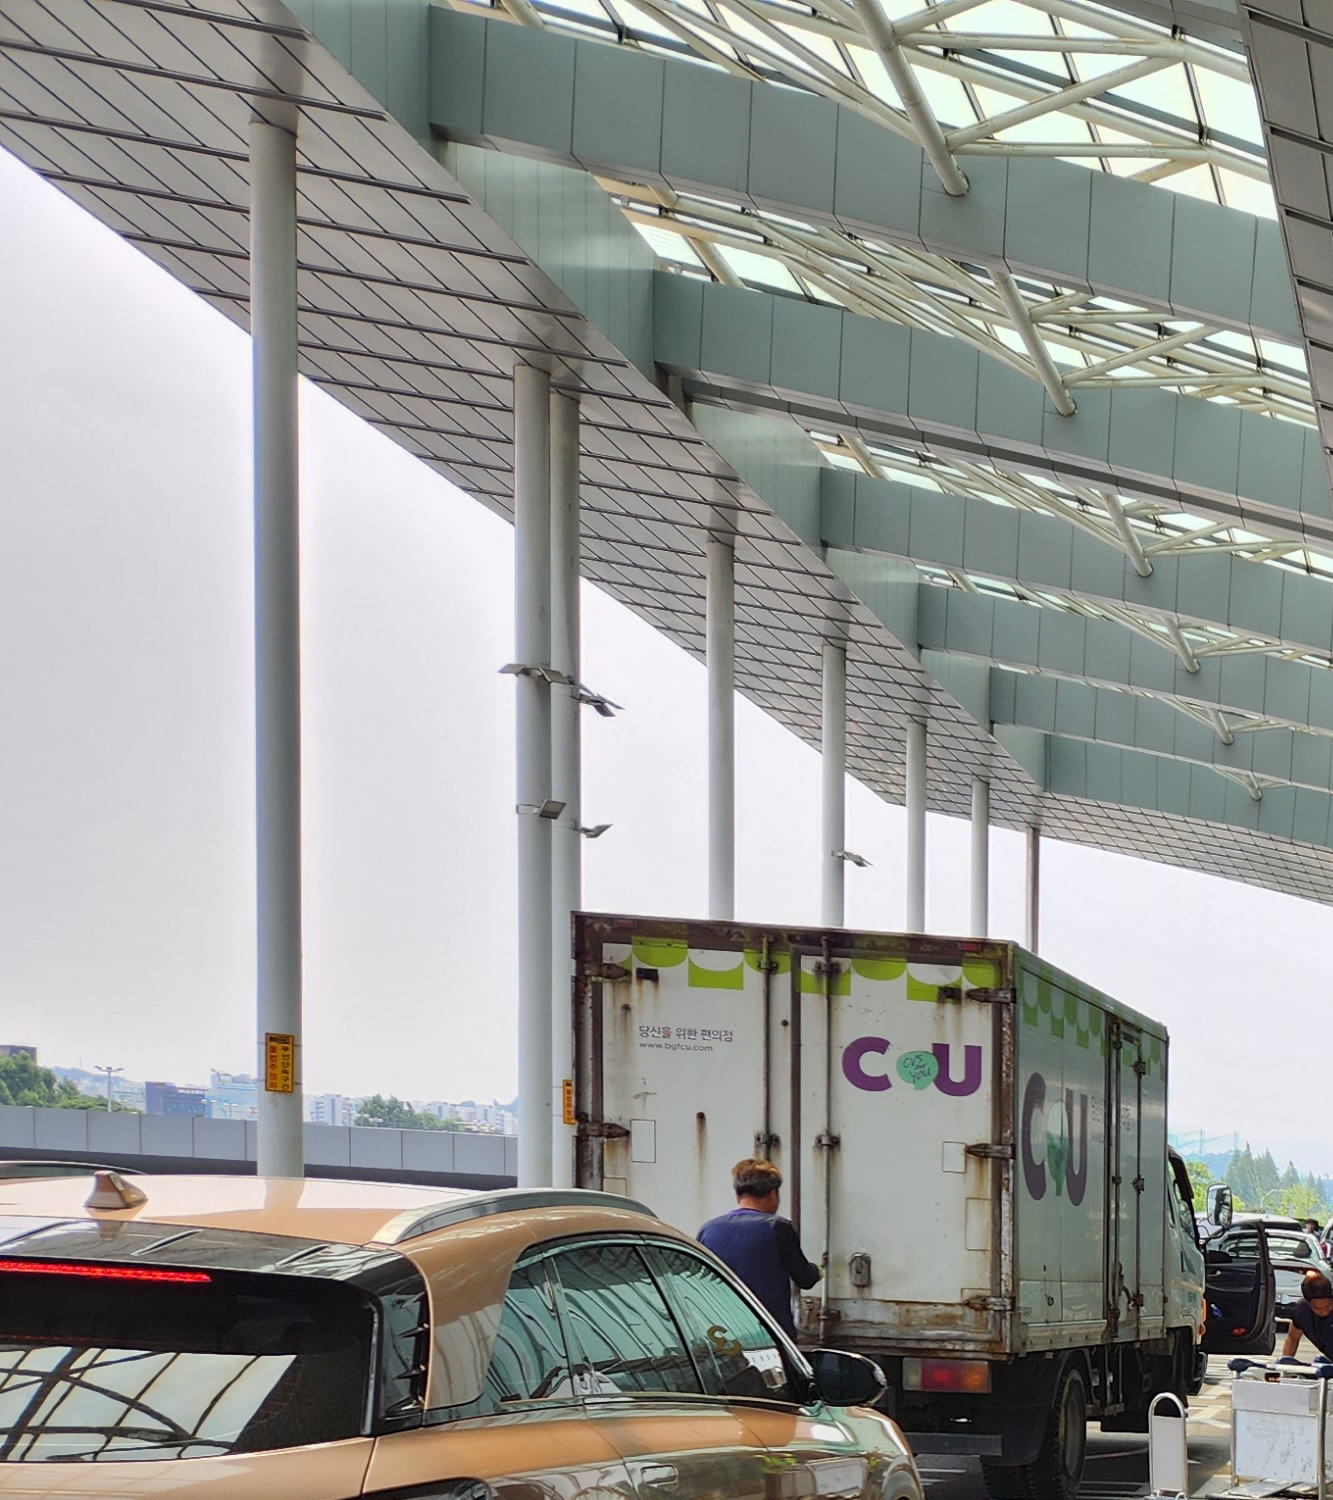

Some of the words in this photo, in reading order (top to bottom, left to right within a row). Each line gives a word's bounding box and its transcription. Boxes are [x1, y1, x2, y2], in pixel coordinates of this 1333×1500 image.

[639, 1025, 672, 1039] 당신을
[675, 1027, 698, 1040] 위한
[701, 1028, 733, 1043] 편의점
[639, 1042, 713, 1052] www.bgfcu.com
[842, 1036, 982, 1096] CU
[1022, 1072, 1088, 1206] CU
